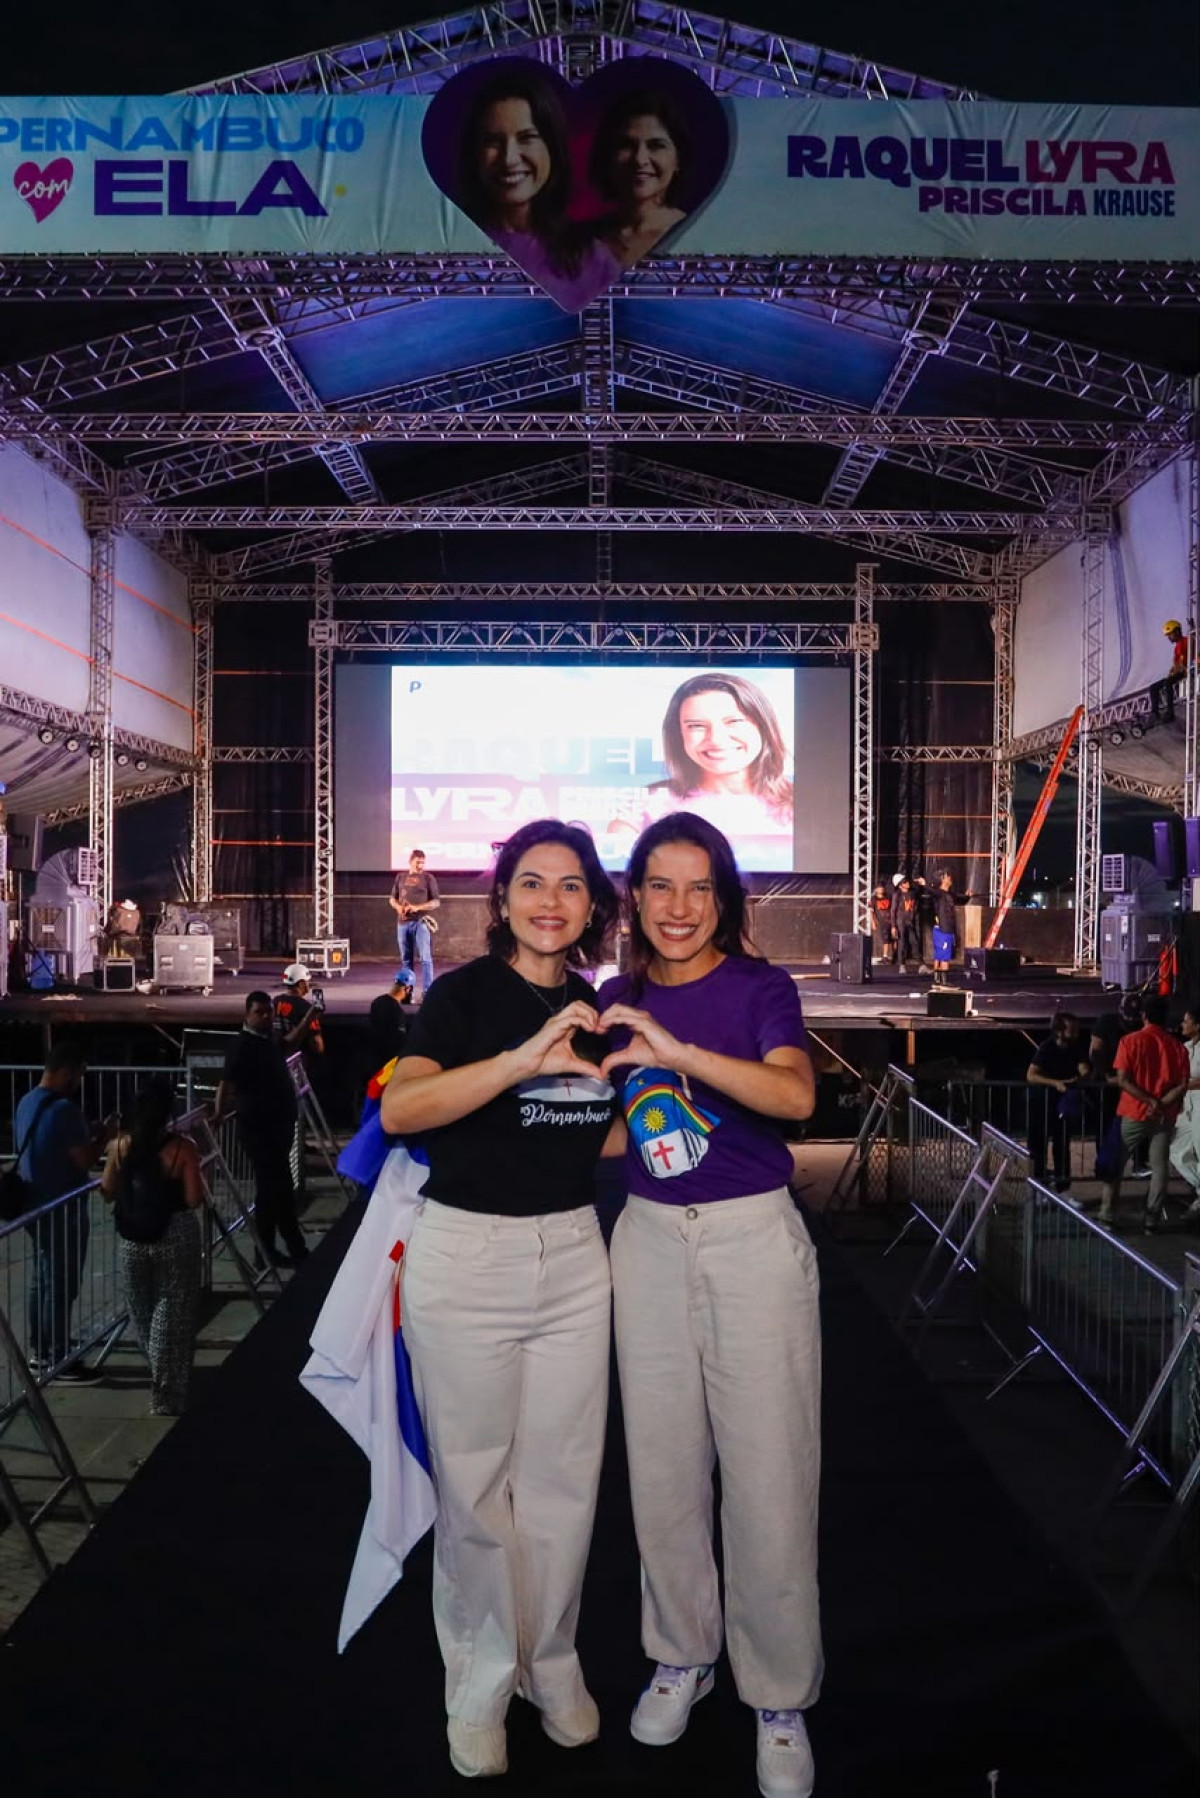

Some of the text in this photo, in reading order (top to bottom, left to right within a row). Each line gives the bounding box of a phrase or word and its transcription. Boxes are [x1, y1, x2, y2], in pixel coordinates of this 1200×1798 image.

[0, 117, 365, 152] PERNAMBUCO
[787, 135, 1176, 187] RAQUEL LYRA
[17, 160, 329, 216] com ELA
[919, 186, 1176, 217] PRISCILA KRAUSE
[391, 786, 546, 822] LYRA
